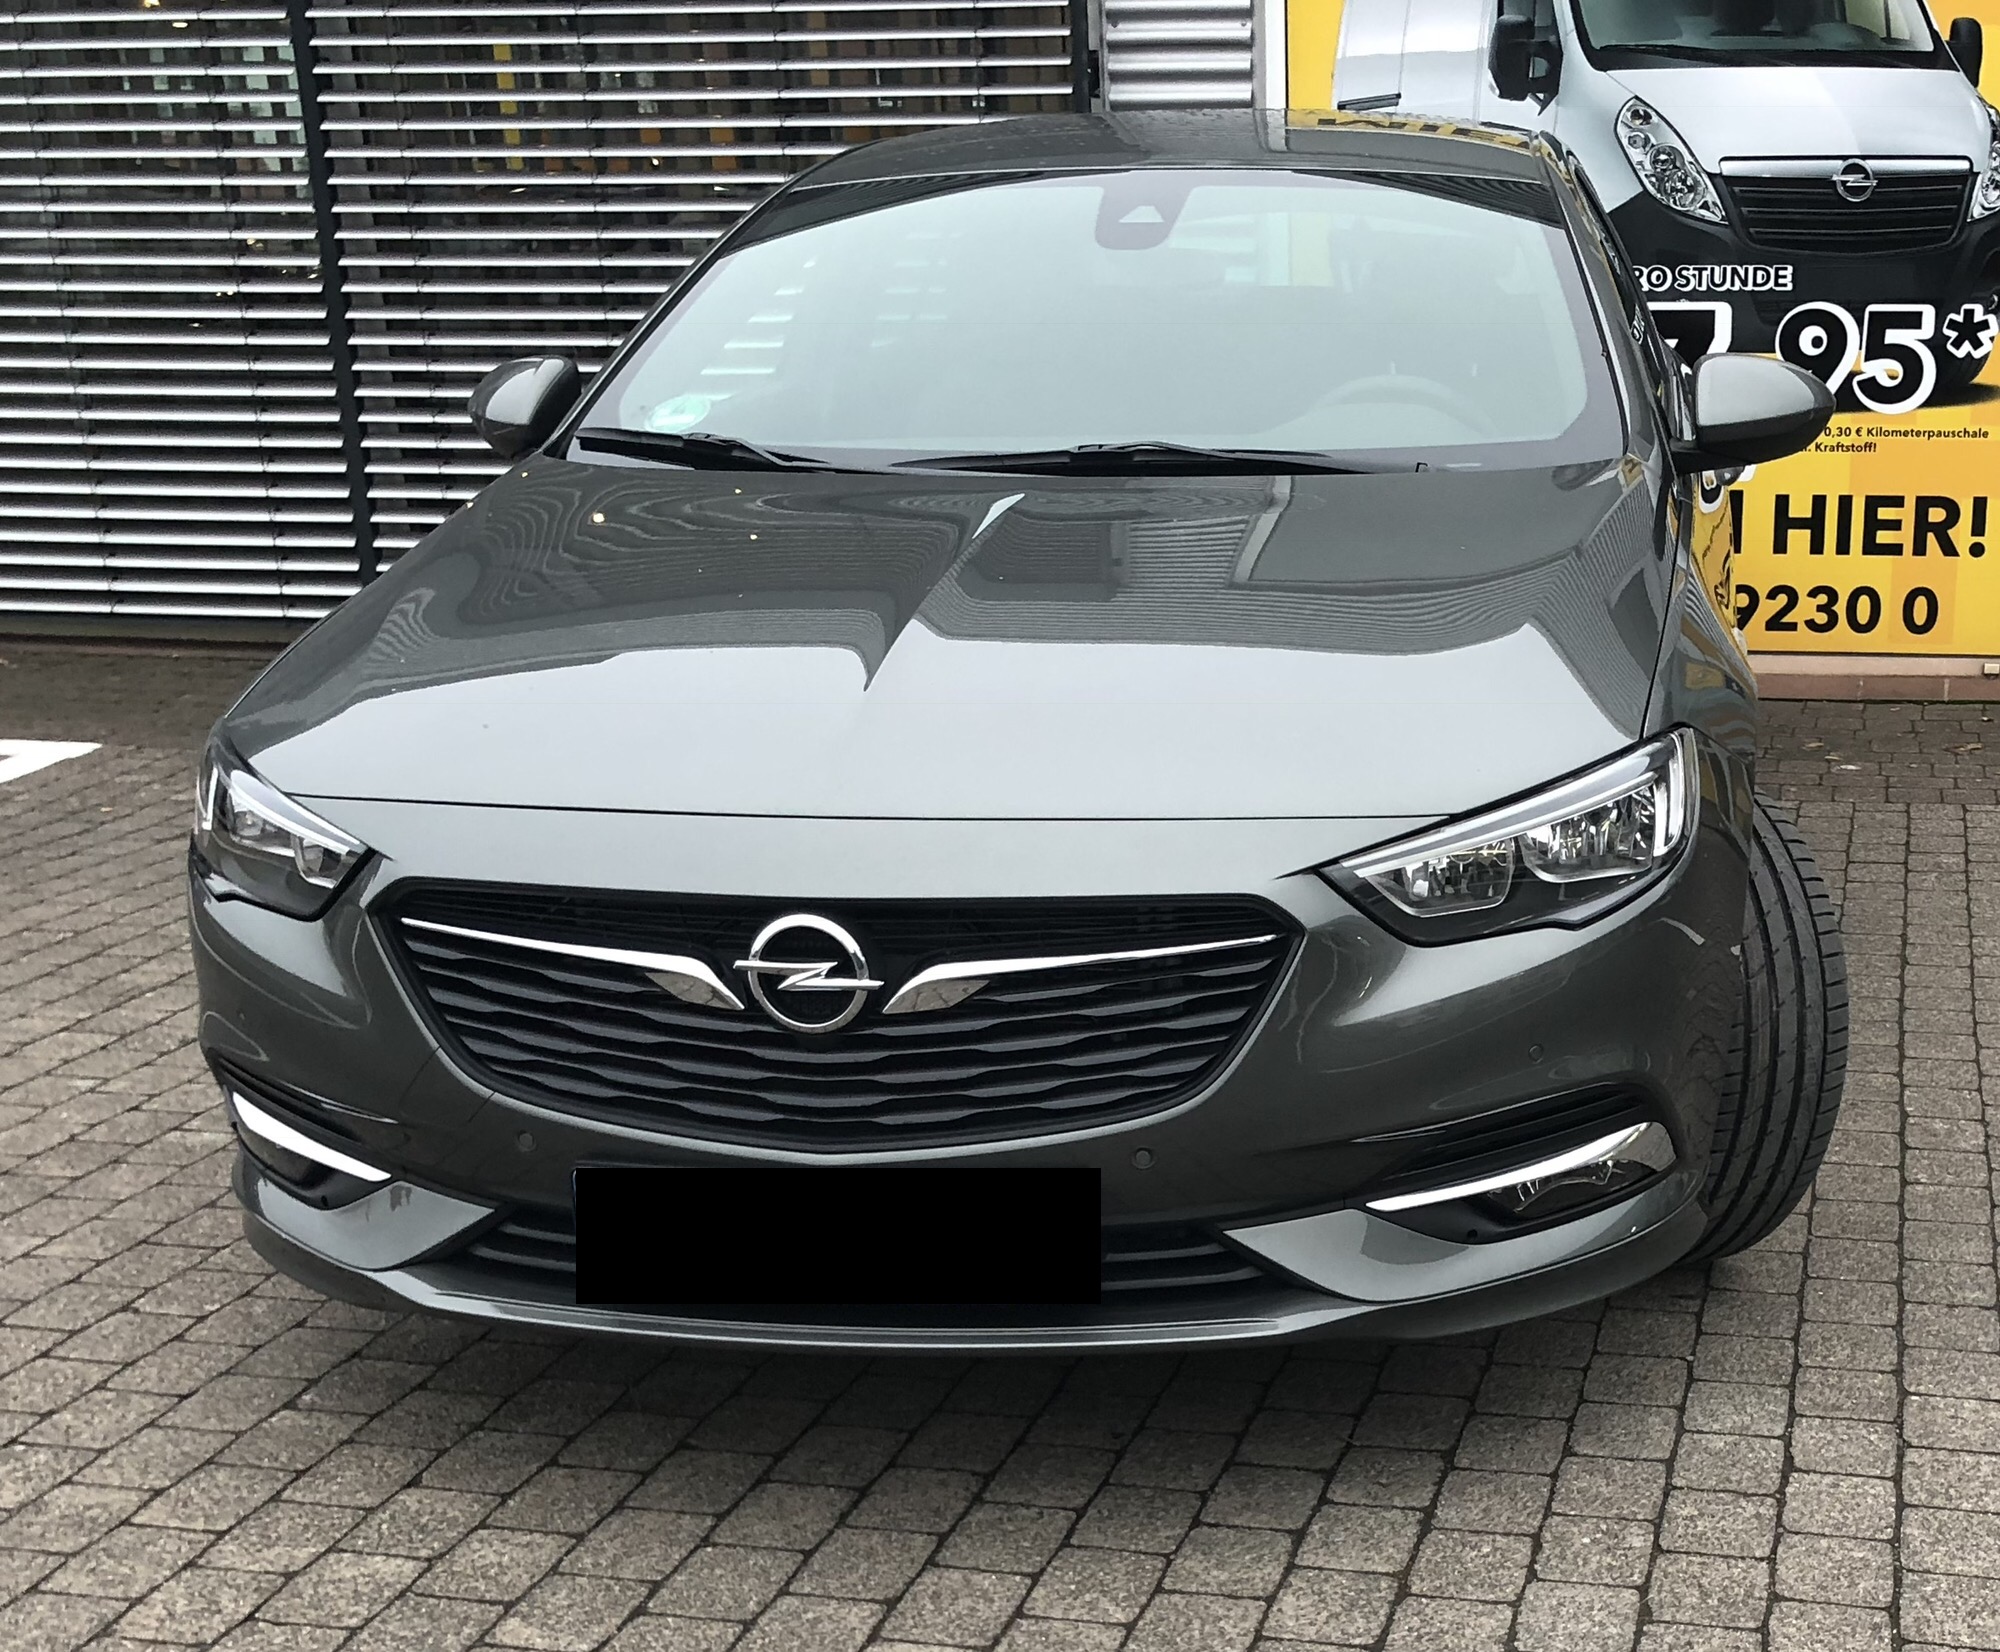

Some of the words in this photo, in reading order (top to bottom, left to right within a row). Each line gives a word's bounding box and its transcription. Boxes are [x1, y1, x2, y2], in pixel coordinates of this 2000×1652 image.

[1673, 264, 1794, 292] STUNDE
[1814, 441, 1877, 453] Kraftstoff!
[1824, 426, 1852, 438] 0,30
[1855, 426, 1864, 438] €
[1866, 426, 1989, 441] Kilometerpauschale
[1773, 493, 1988, 558] HIER!
[1735, 583, 1882, 634] 9230
[1902, 586, 1939, 635] 0
